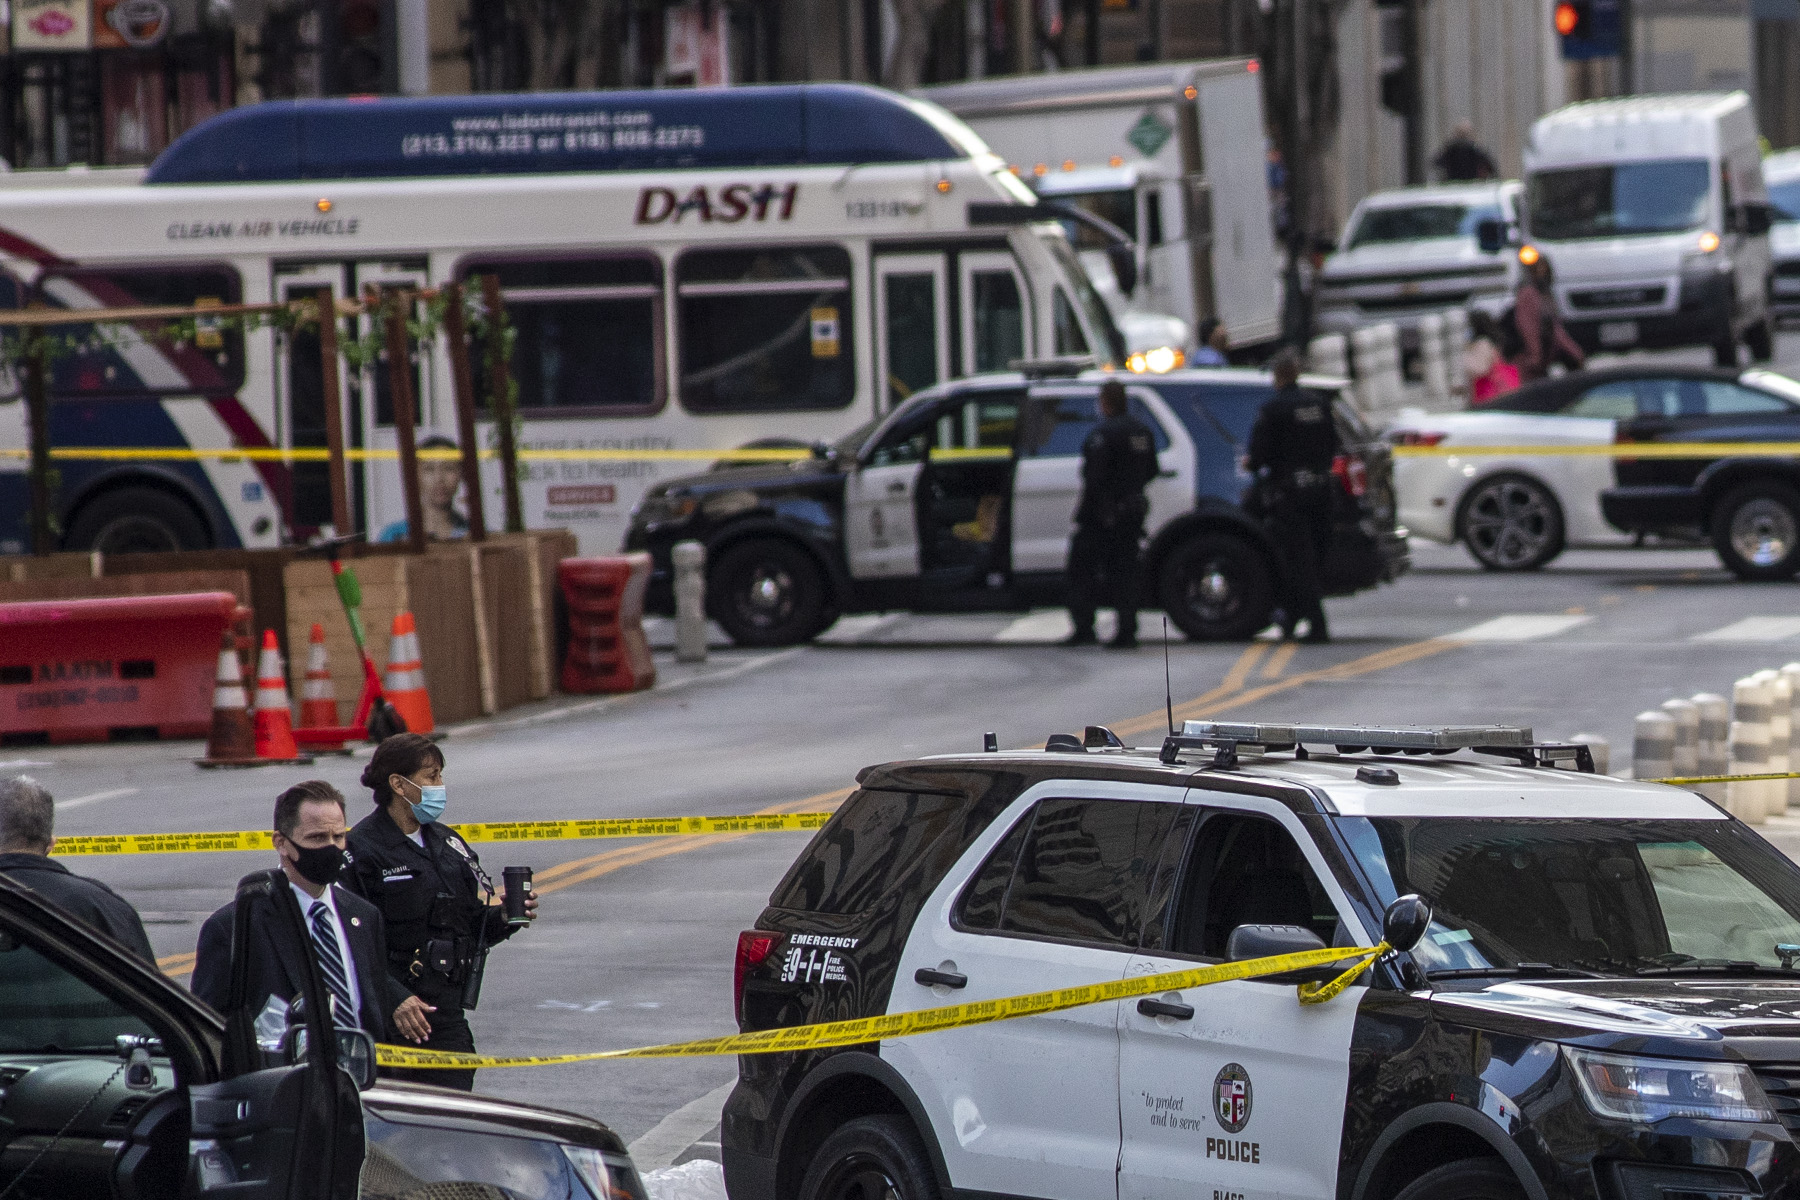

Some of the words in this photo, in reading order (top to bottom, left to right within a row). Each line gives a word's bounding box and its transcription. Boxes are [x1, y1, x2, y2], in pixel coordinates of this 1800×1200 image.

[634, 182, 798, 224] DASH
[167, 222, 232, 239] CLEAN
[238, 220, 272, 237] AIR
[277, 219, 359, 236] VEHICLE
[790, 934, 859, 948] EMERGENCY
[781, 947, 794, 982] CALL
[788, 947, 831, 984] 9-1-1
[827, 965, 845, 973] POLICE
[825, 973, 847, 981] MEDICAL
[1155, 1095, 1184, 1112] protect
[1151, 1111, 1167, 1127] and
[1169, 1115, 1178, 1128] to
[1206, 1137, 1260, 1164] POLICE
